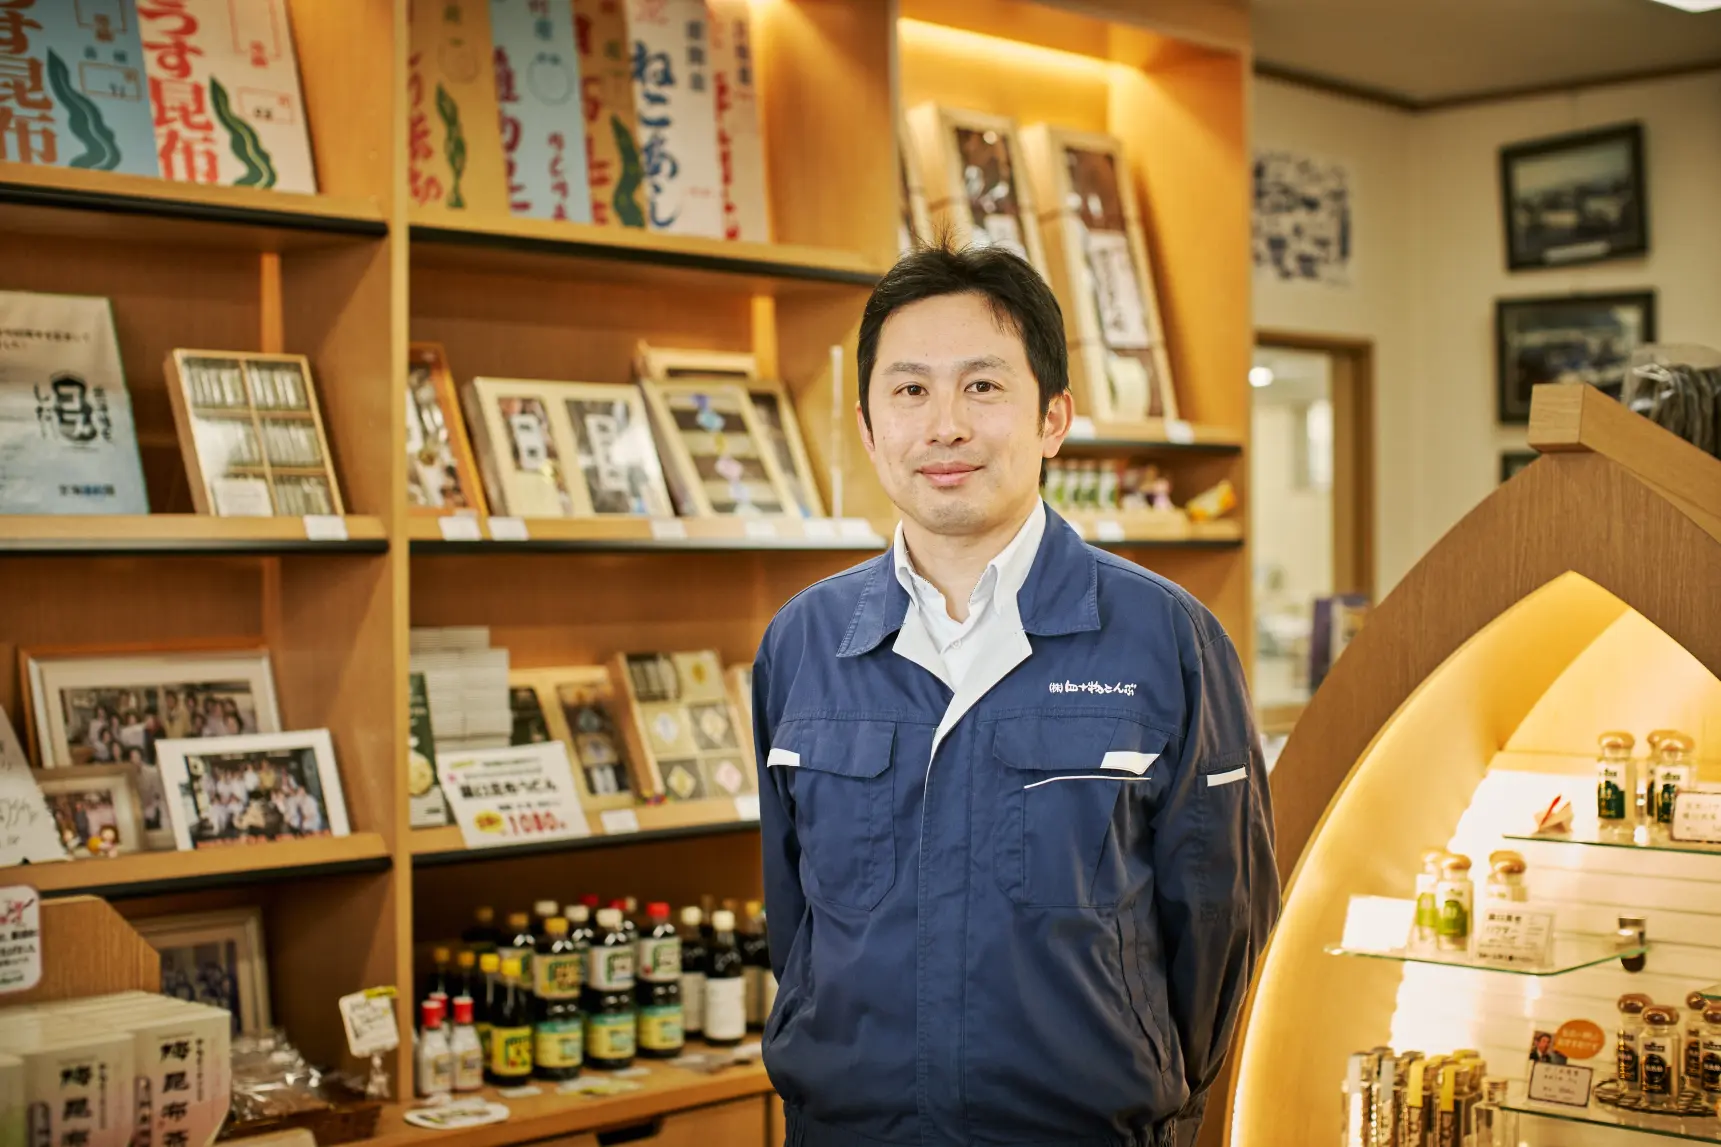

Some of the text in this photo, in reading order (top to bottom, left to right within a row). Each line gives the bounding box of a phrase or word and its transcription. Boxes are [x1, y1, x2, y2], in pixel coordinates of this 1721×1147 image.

[0, 0, 57, 164] す昆布
[633, 39, 683, 228] ねこあし
